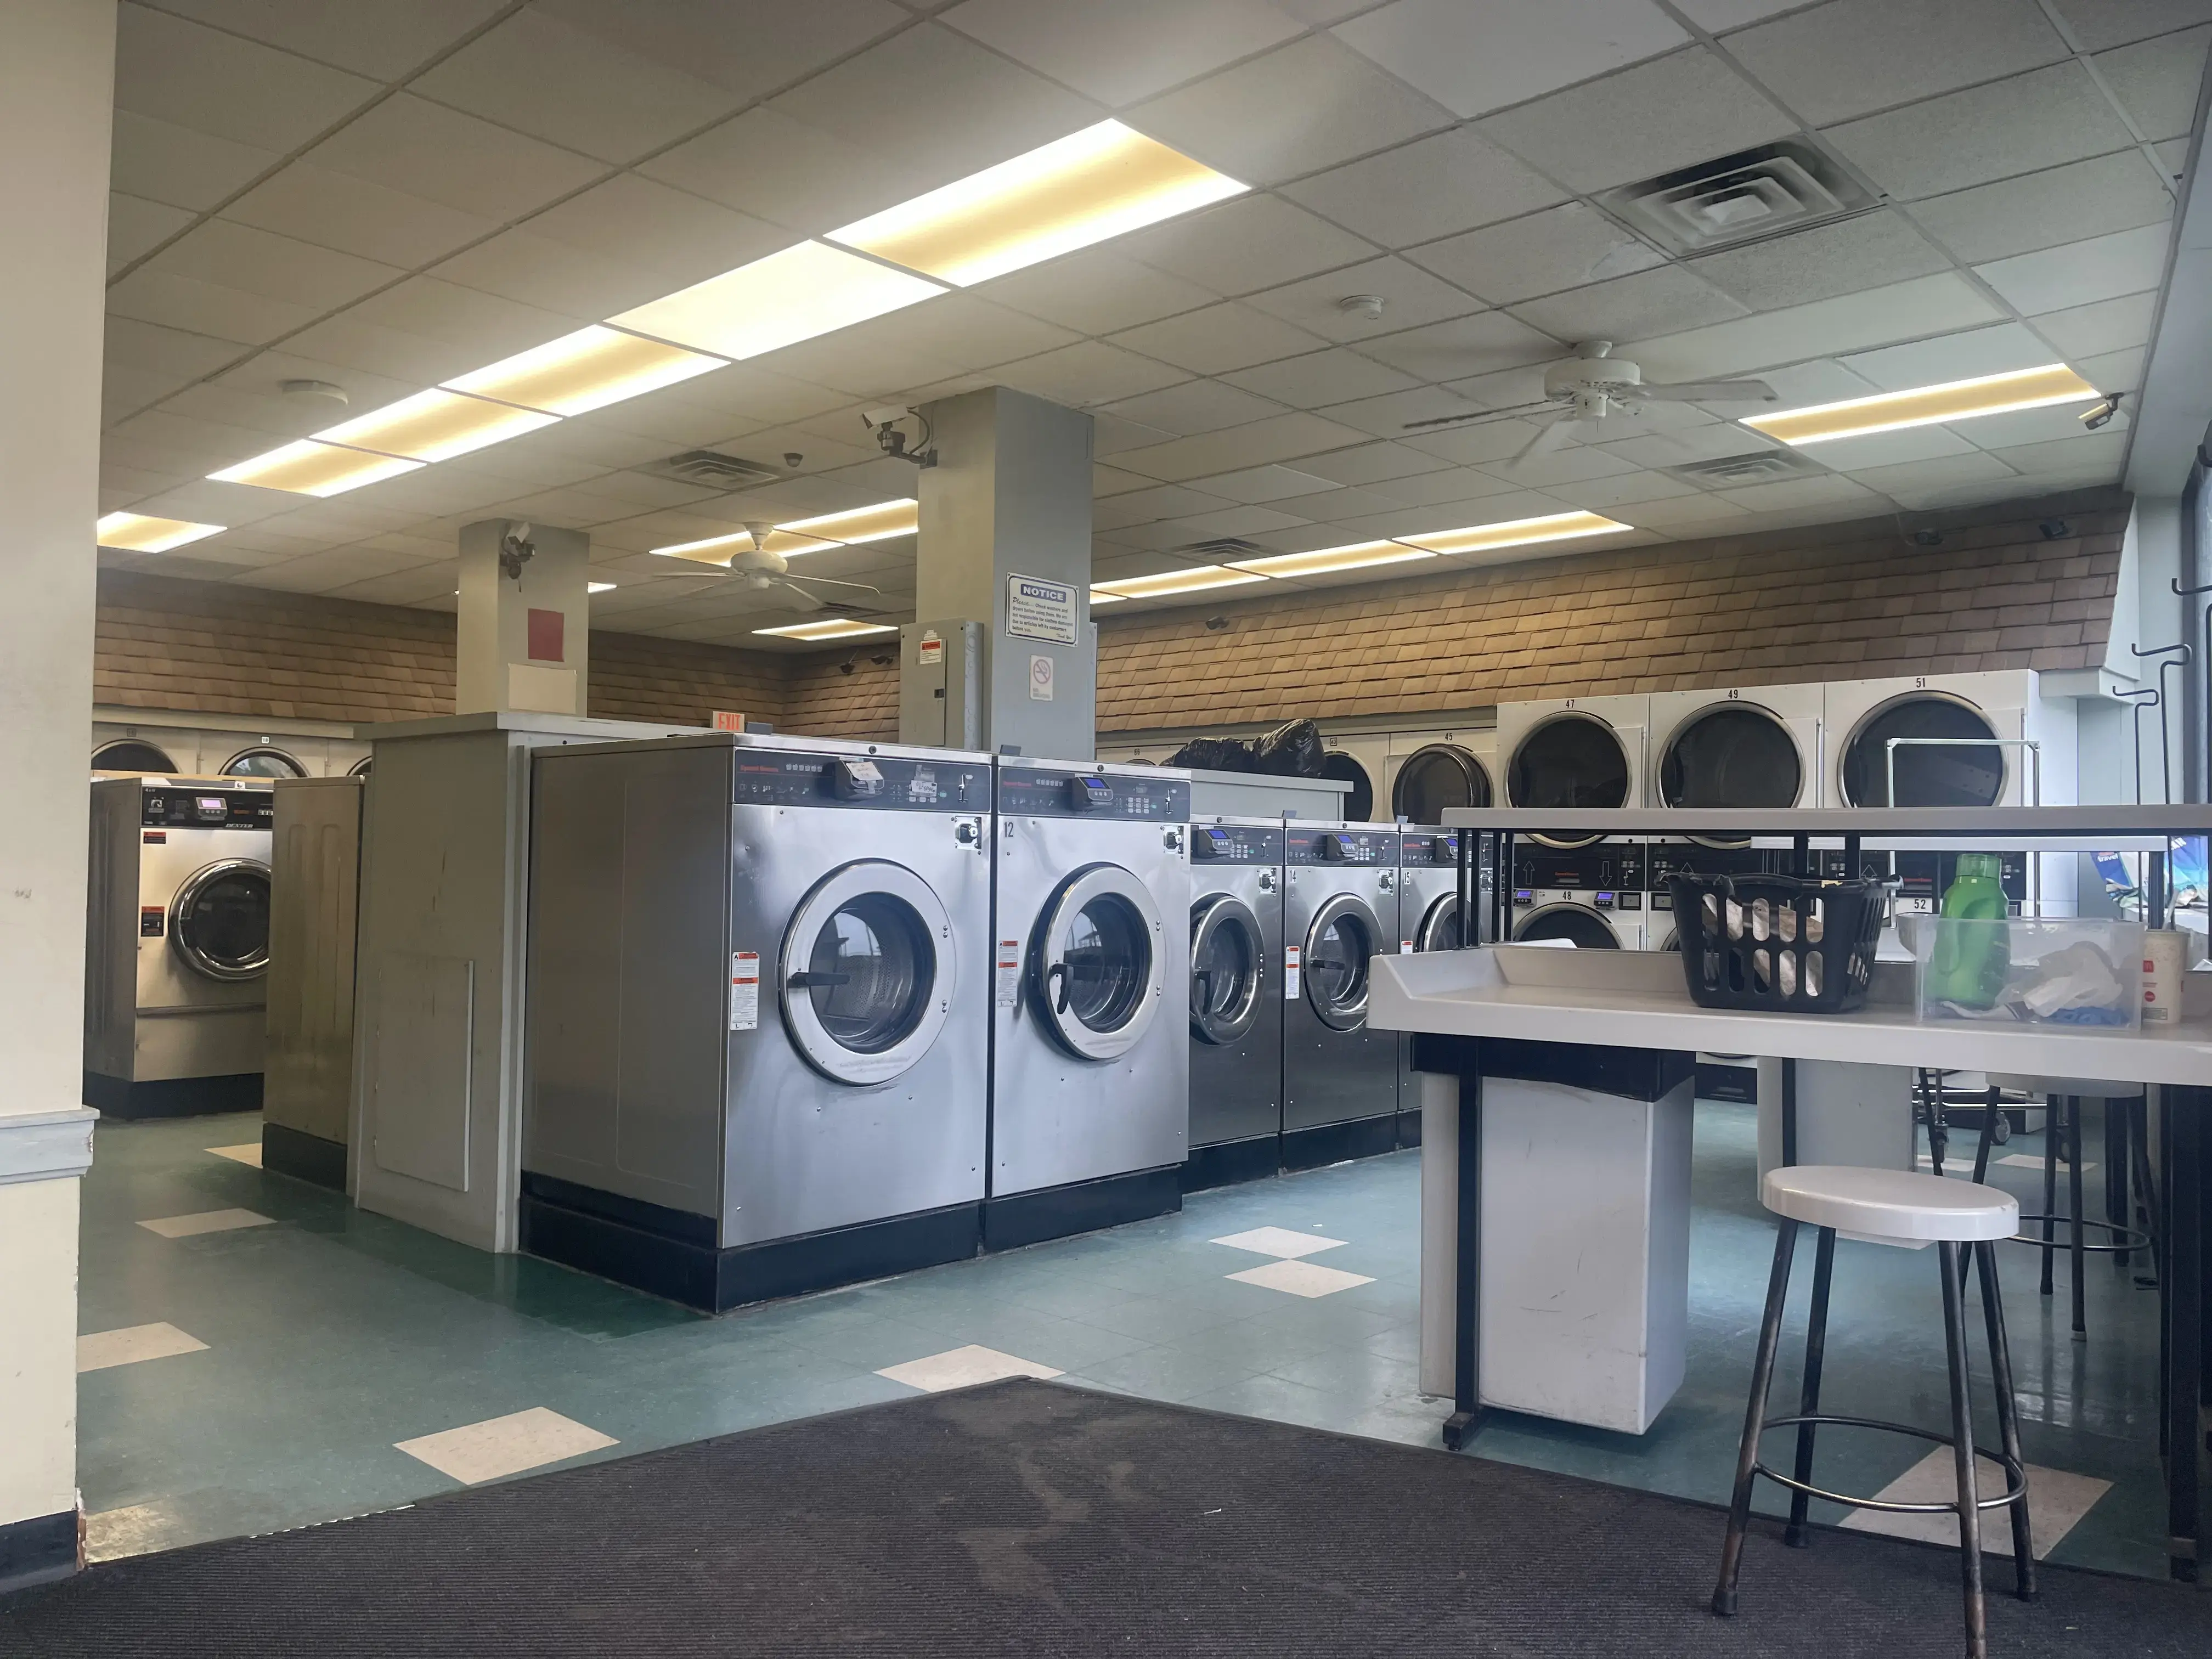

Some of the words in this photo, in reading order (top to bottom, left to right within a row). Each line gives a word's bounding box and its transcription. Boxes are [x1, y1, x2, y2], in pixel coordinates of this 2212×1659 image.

[1023, 586, 1064, 601] NOTICE
[1916, 677, 1925, 687] 51
[1728, 689, 1738, 699] 49
[1566, 699, 1575, 708] 47
[718, 713, 741, 730] EXIT
[1444, 732, 1453, 741] 45
[1004, 821, 1014, 838] 12
[2097, 853, 2119, 862] travel
[1290, 870, 1296, 883] 14
[1404, 872, 1410, 883] 15
[1562, 891, 1571, 900] 48
[1914, 899, 1926, 909] 52
